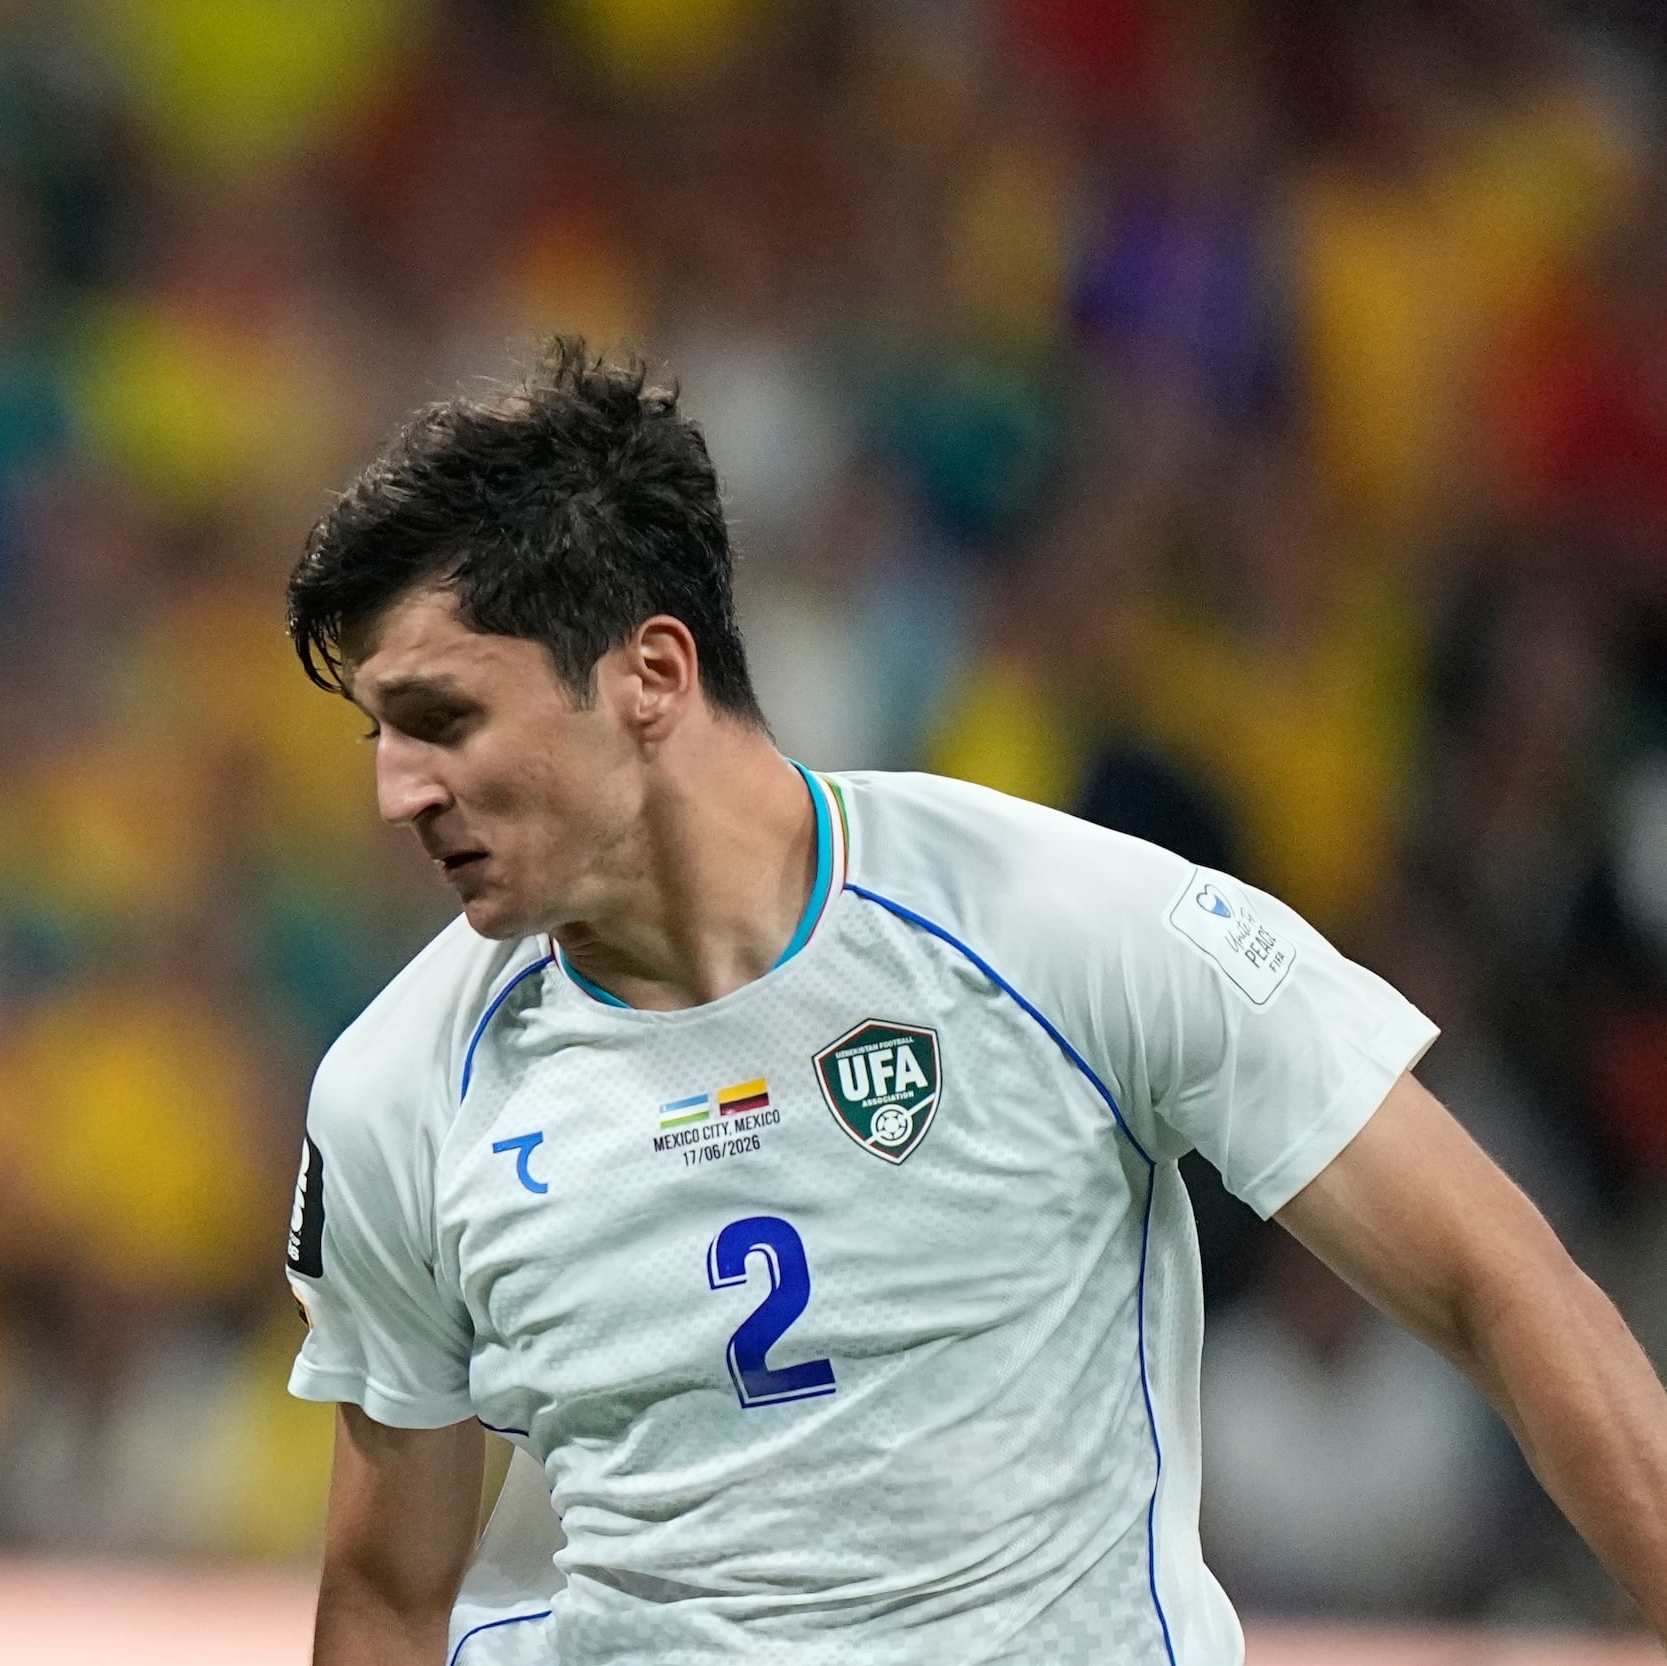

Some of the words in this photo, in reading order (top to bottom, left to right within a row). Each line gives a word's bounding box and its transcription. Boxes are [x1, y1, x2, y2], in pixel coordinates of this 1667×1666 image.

[1244, 925, 1276, 968] PEACE
[1269, 951, 1285, 973] FIFA
[878, 1036, 915, 1050] FOOTBALL
[837, 1044, 929, 1102] UFA
[861, 1090, 916, 1108] ASSOCIATION
[653, 1128, 700, 1153] MEXICO
[734, 1109, 781, 1133] MEXICO
[683, 1134, 762, 1167] 17/06/2026
[706, 1215, 836, 1409] 2
